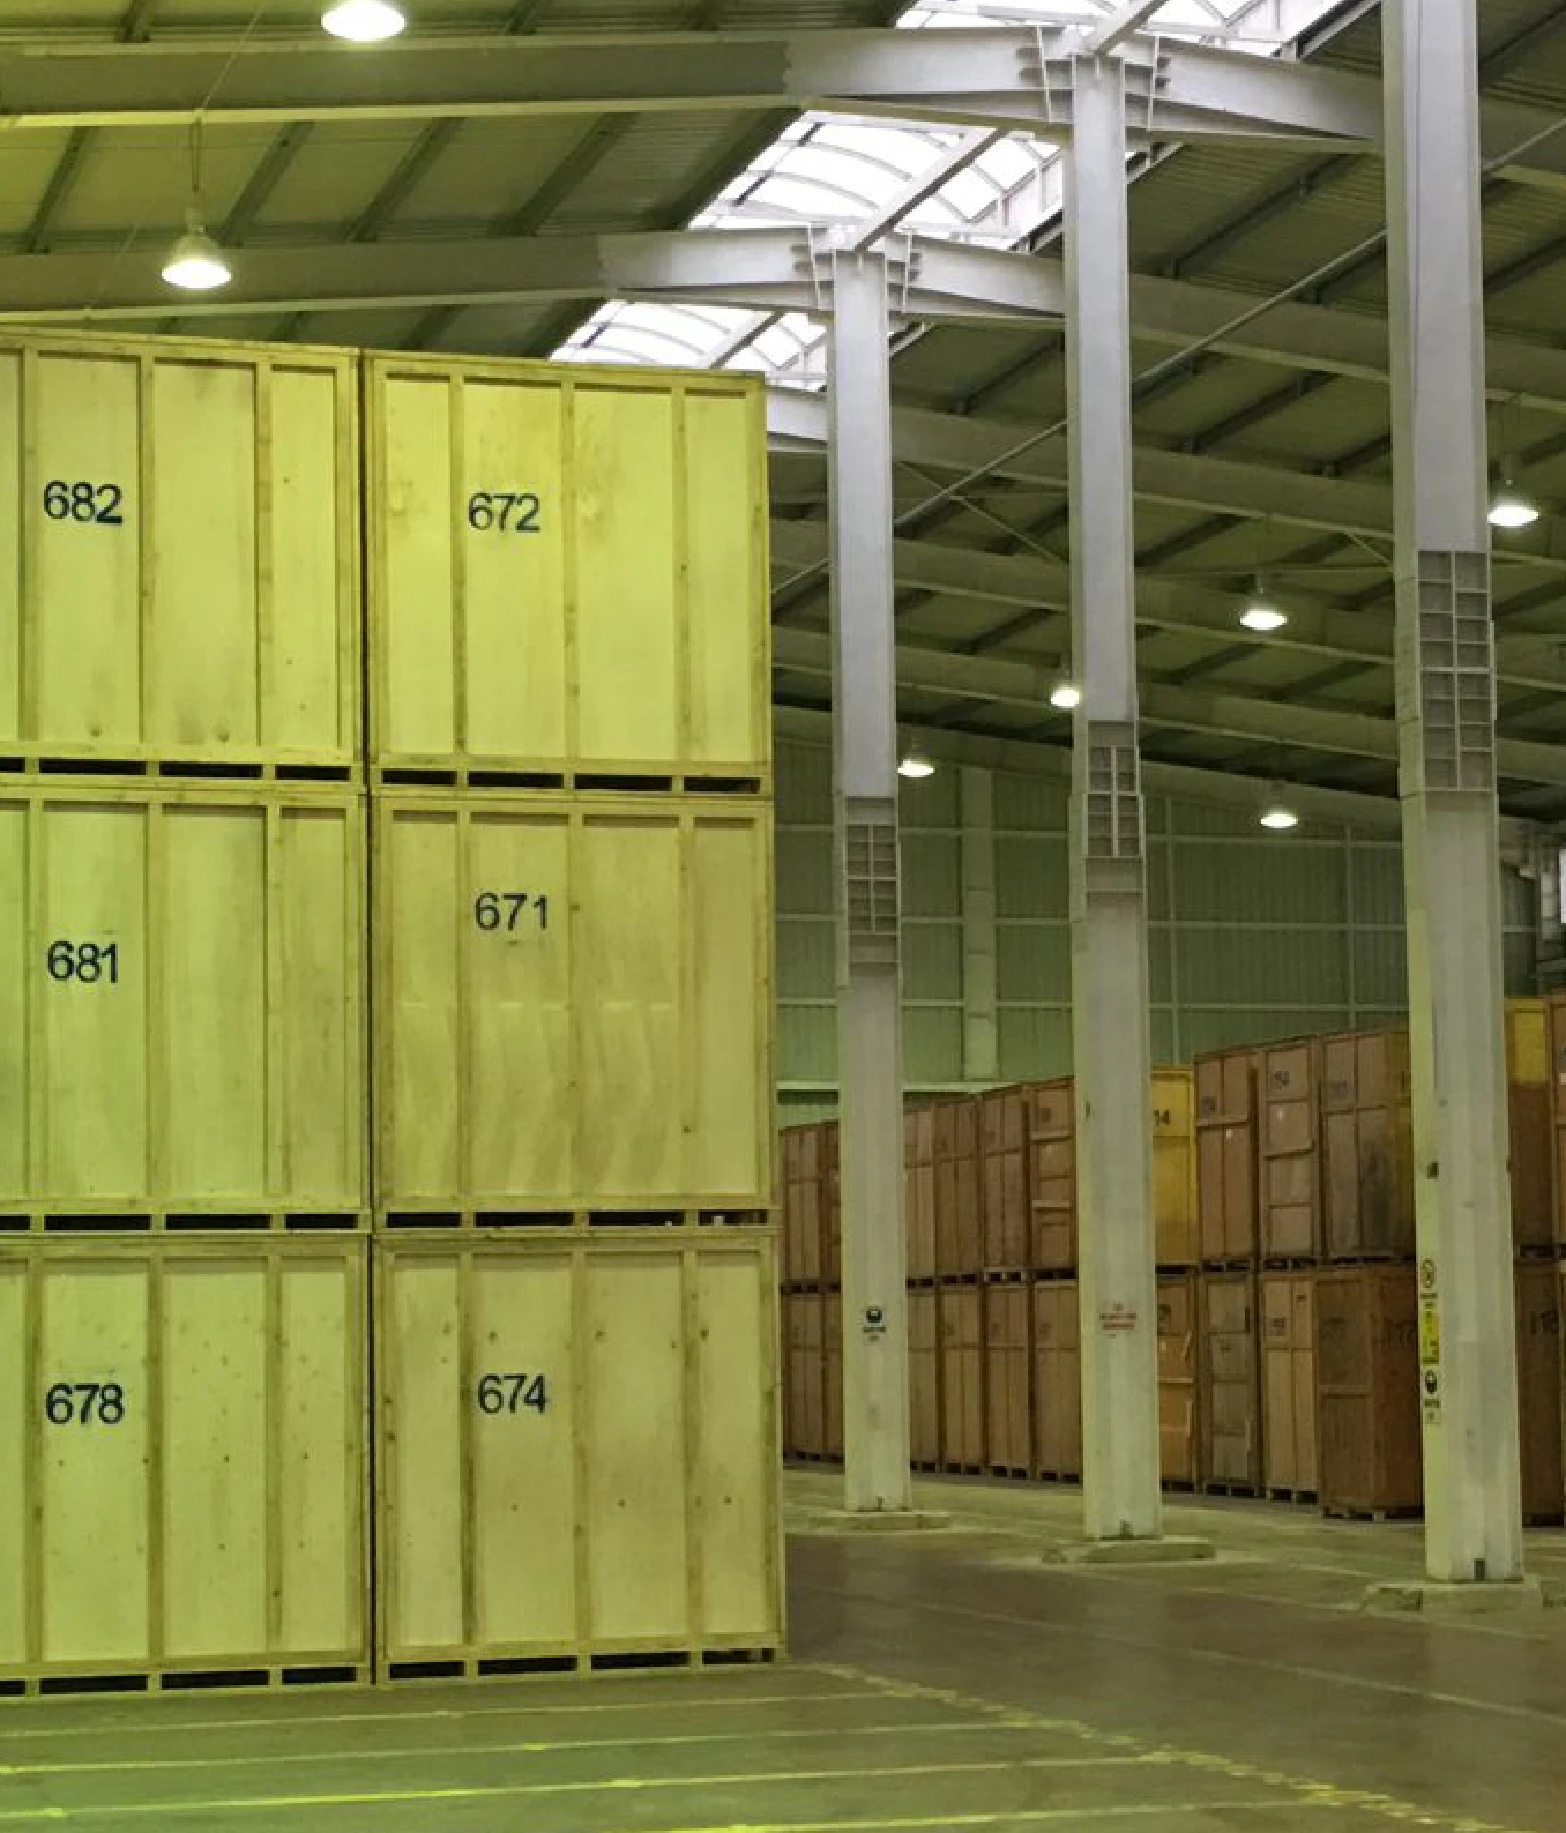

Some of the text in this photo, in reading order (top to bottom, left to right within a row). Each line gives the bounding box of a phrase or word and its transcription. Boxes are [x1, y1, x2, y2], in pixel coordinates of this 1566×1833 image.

[42, 481, 124, 525] 682
[467, 492, 541, 532] 672
[474, 891, 549, 932] 671
[46, 940, 119, 984] 681
[44, 1383, 125, 1425] 678
[476, 1375, 547, 1415] 674
